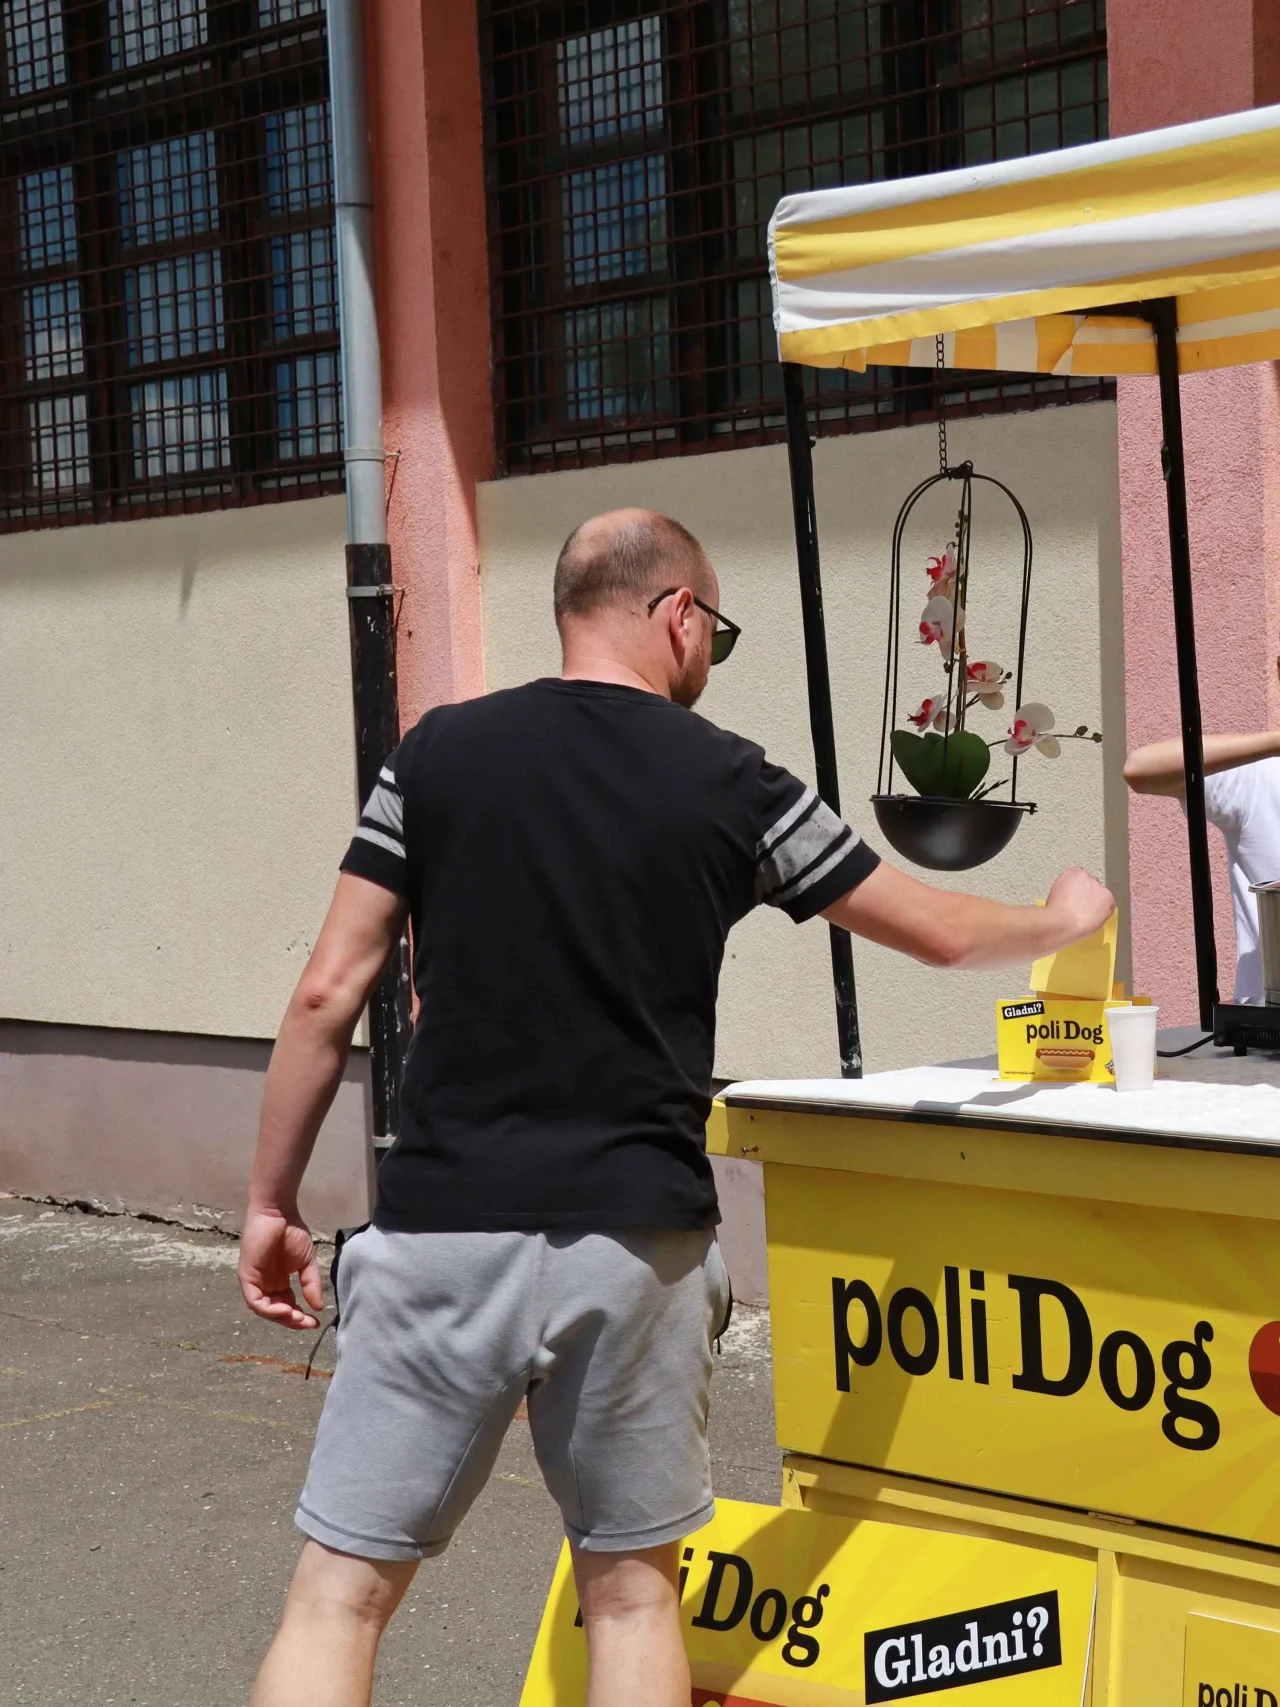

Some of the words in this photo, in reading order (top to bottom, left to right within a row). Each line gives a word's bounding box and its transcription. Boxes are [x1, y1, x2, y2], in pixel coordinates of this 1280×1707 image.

[1004, 1003, 1042, 1018] Gladni?
[1026, 1020, 1060, 1044] poli
[1063, 1020, 1104, 1045] Dog
[831, 1265, 990, 1393] poli
[1007, 1273, 1221, 1451] Dog
[691, 1550, 831, 1668] Dog
[873, 1606, 1050, 1690] Gladni?
